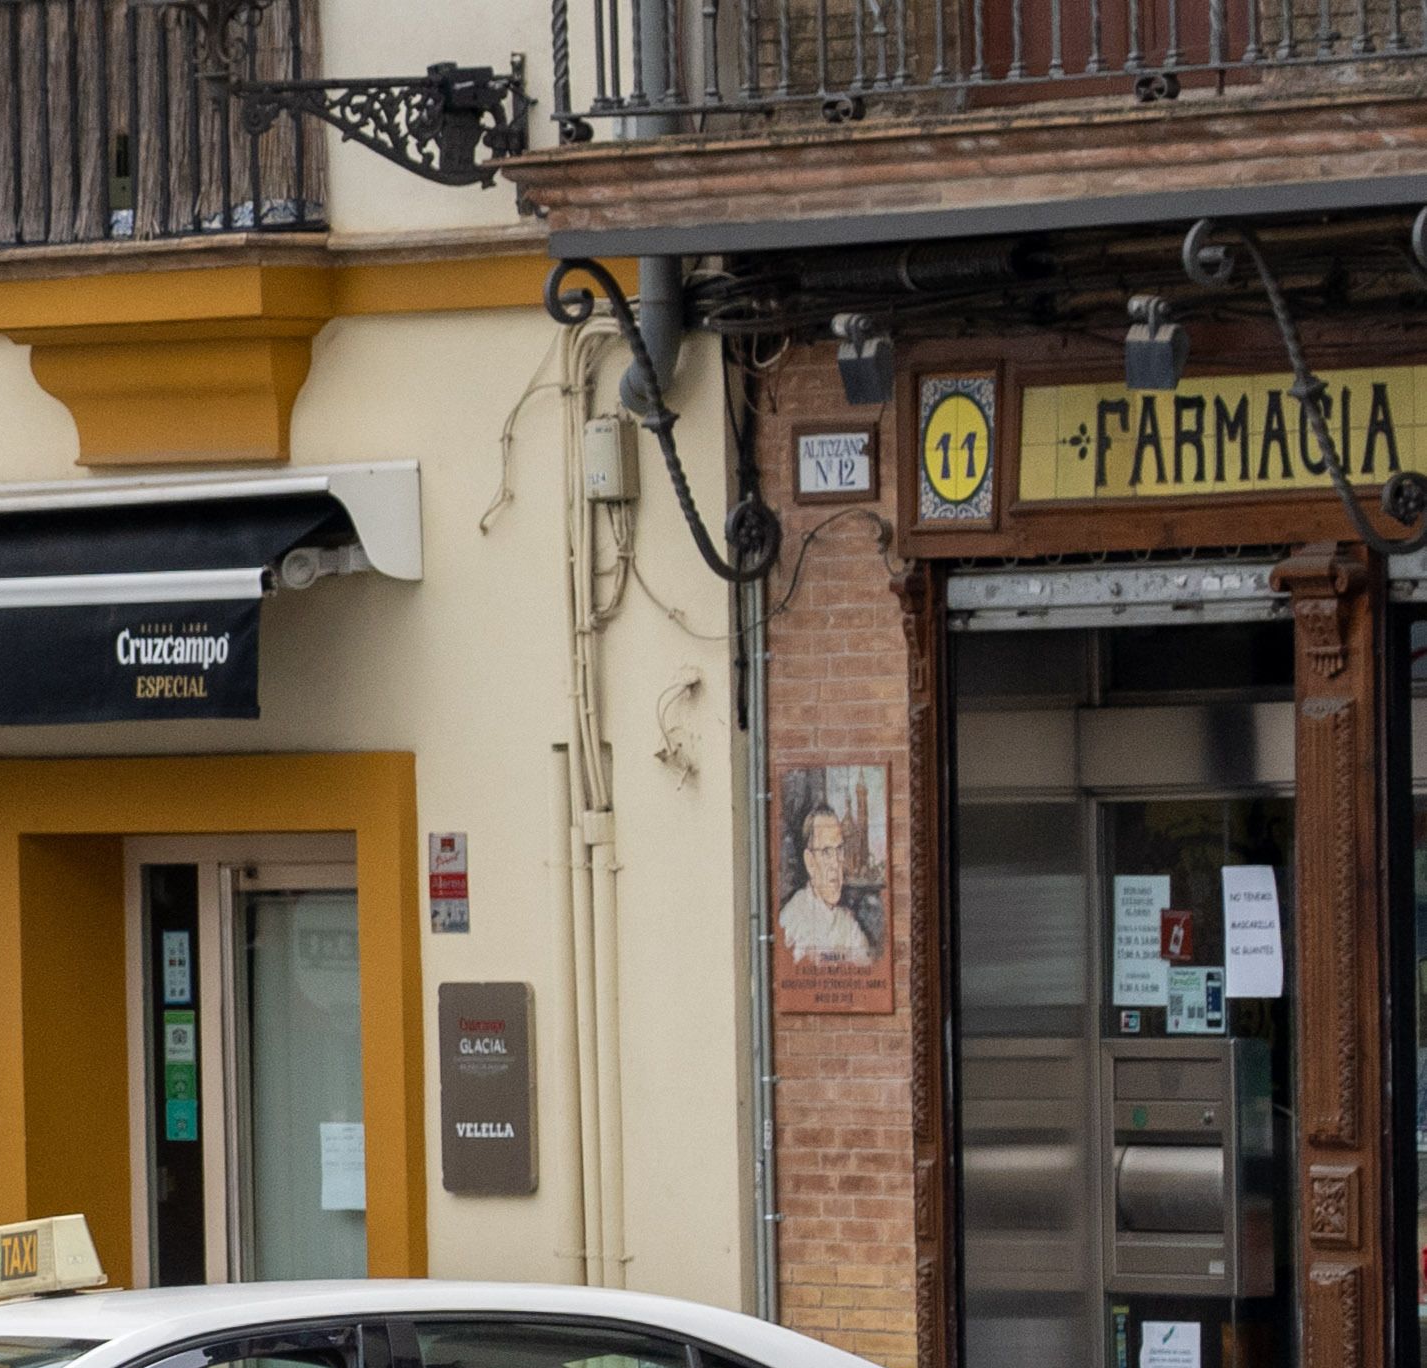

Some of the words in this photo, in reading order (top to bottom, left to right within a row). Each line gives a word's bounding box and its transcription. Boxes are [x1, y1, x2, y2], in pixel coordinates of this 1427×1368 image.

[1096, 383, 1402, 487] FARMACIA
[838, 459, 855, 487] 12
[935, 432, 977, 480] 11
[117, 627, 230, 670] Cruzcampo
[136, 675, 208, 699] ESPECIAL
[459, 1038, 508, 1054] GLACIAL
[455, 1122, 515, 1138] VELELLA
[2, 1233, 37, 1276] TAXI
